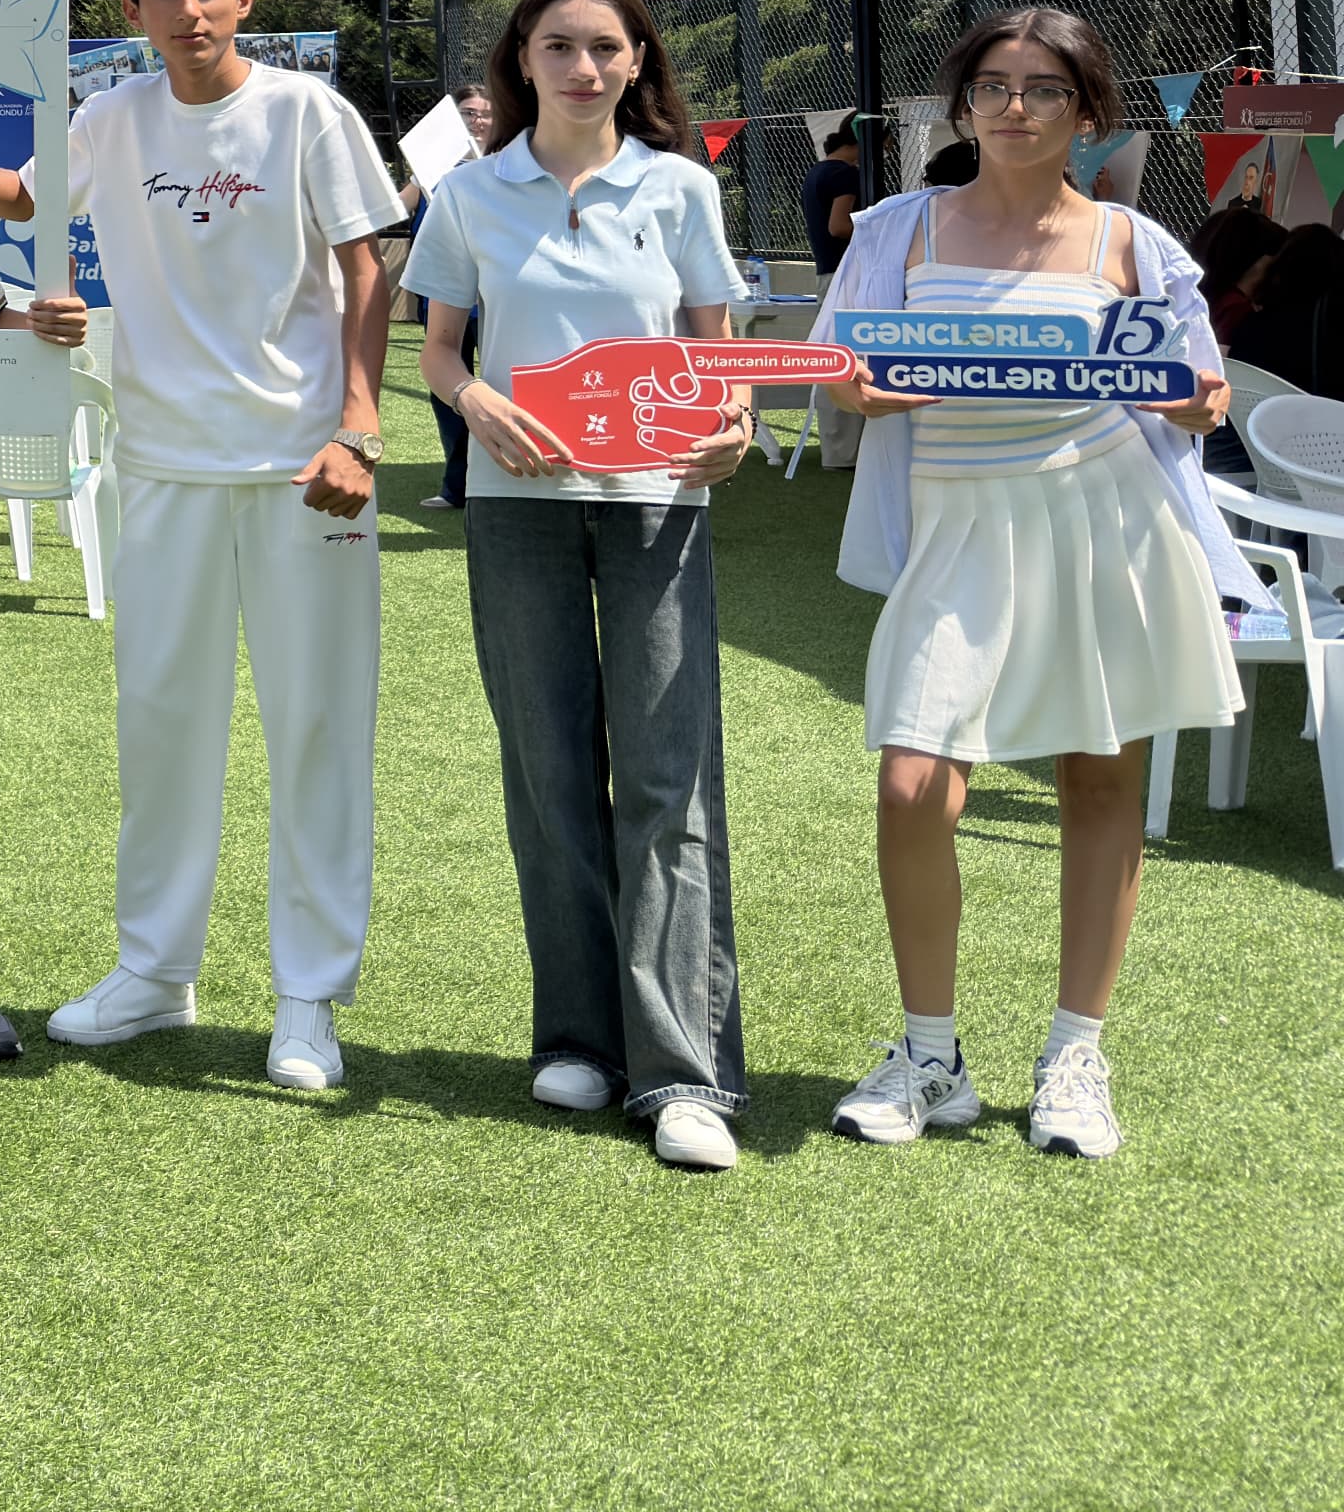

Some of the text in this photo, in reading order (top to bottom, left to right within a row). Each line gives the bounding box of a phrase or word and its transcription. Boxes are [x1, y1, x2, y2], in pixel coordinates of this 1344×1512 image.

[142, 170, 266, 209] Tommy Hilfiger
[851, 321, 1073, 353] GƏNCLƏRLƏ,
[1095, 298, 1170, 357] 15
[781, 355, 838, 368] ünvanı!
[886, 363, 1168, 399] GƏNCLƏR ÜÇÜN
